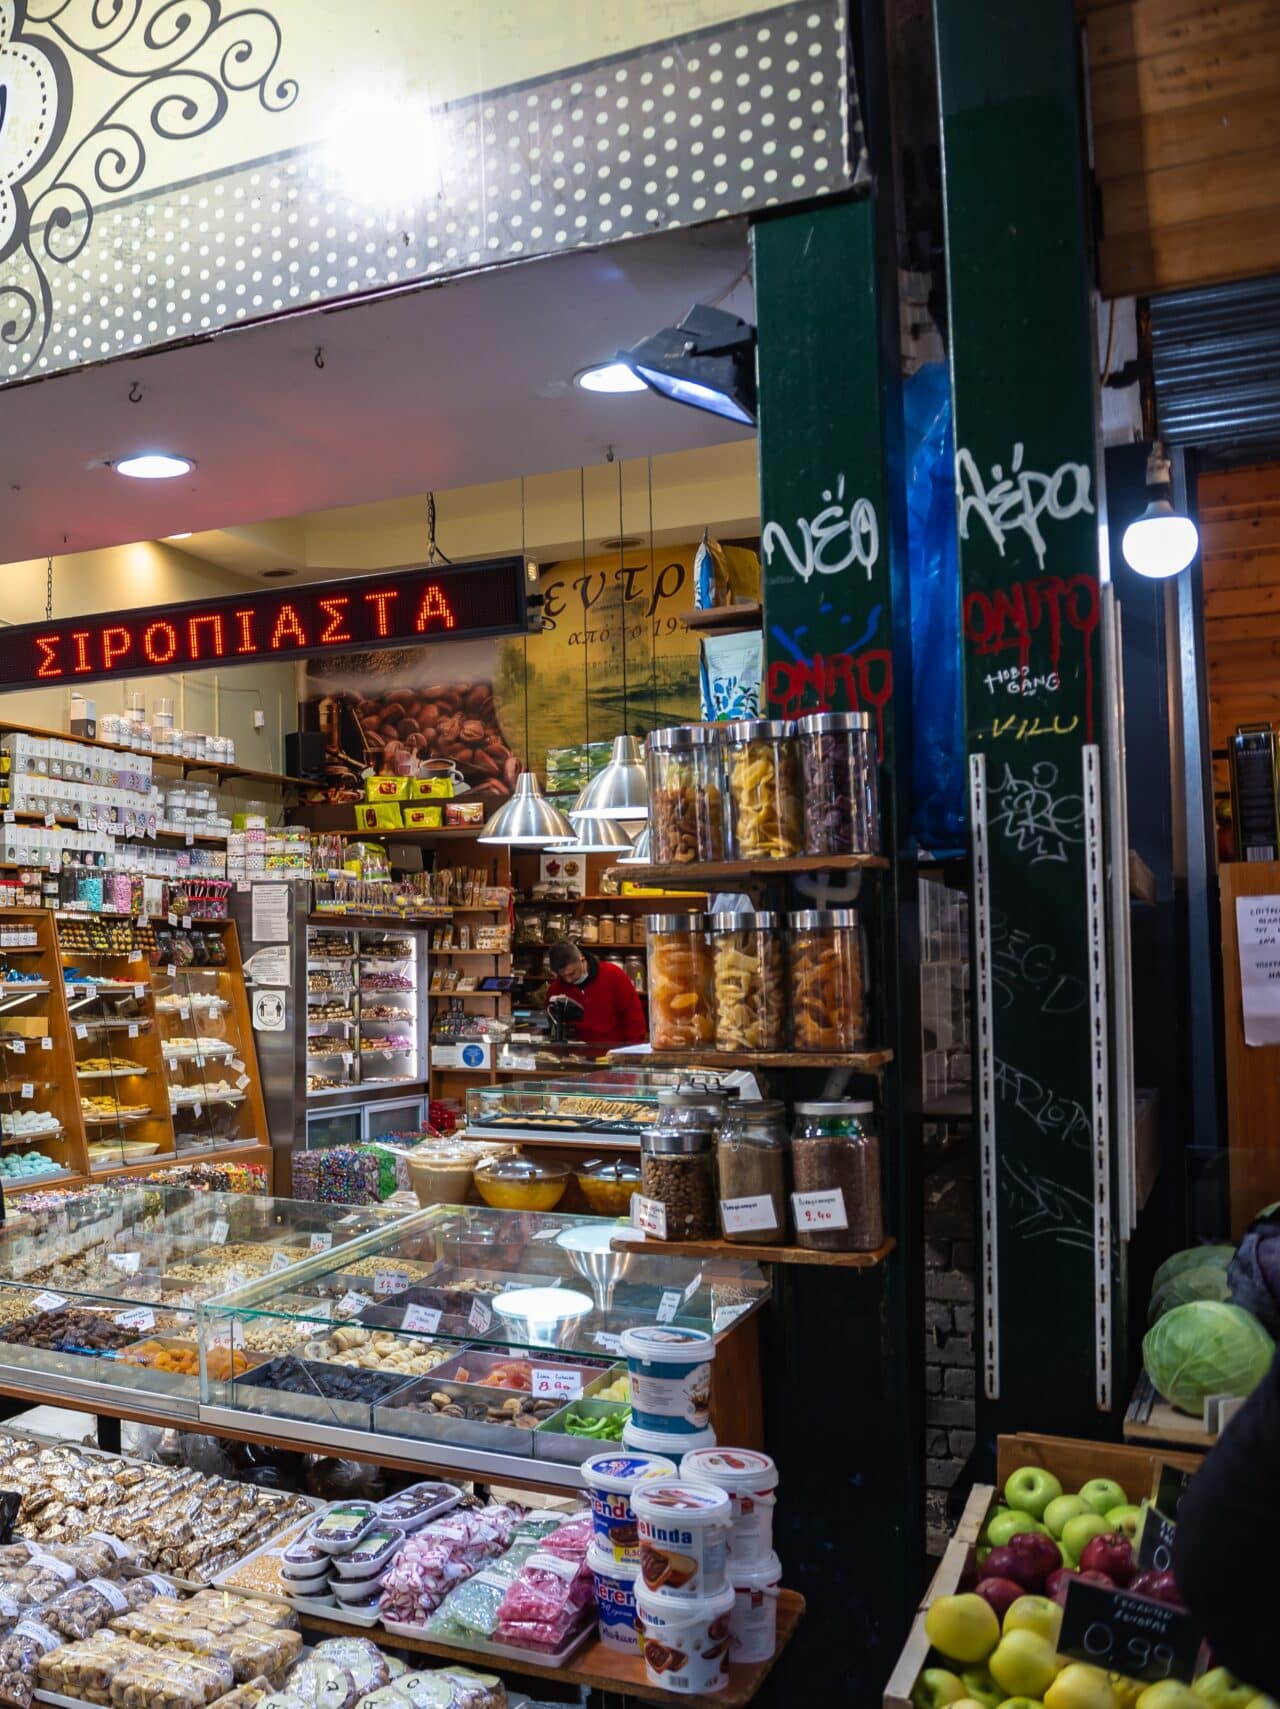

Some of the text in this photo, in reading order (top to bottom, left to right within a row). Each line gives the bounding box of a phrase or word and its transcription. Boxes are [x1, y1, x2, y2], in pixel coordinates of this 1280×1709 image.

[542, 563, 686, 630] εντρ
[36, 586, 455, 678] ΣΙΡΟΠΙΑΣΤΑ
[640, 1521, 693, 1545] elinda
